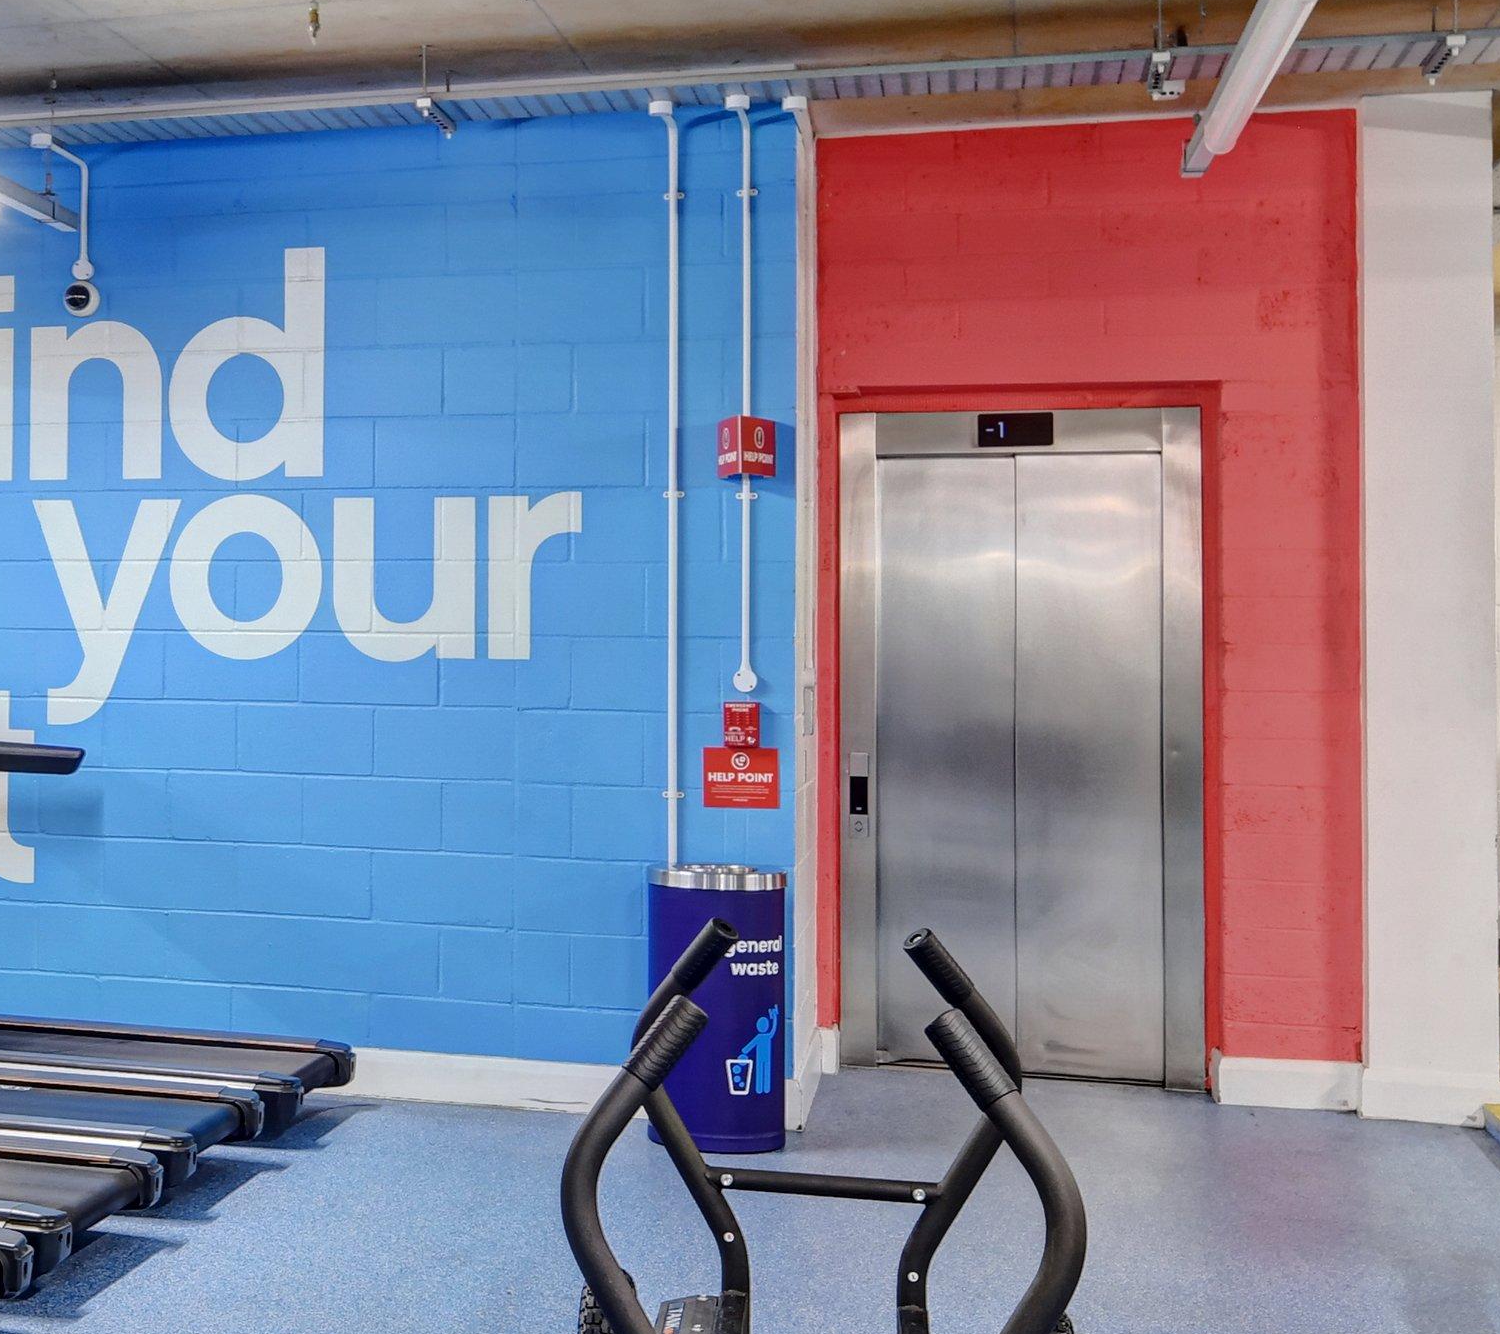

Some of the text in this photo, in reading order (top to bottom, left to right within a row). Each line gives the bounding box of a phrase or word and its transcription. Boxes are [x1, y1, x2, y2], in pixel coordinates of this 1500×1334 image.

[32, 490, 582, 720] your
[708, 771, 774, 784] HELP POINT
[730, 959, 780, 976] waste
